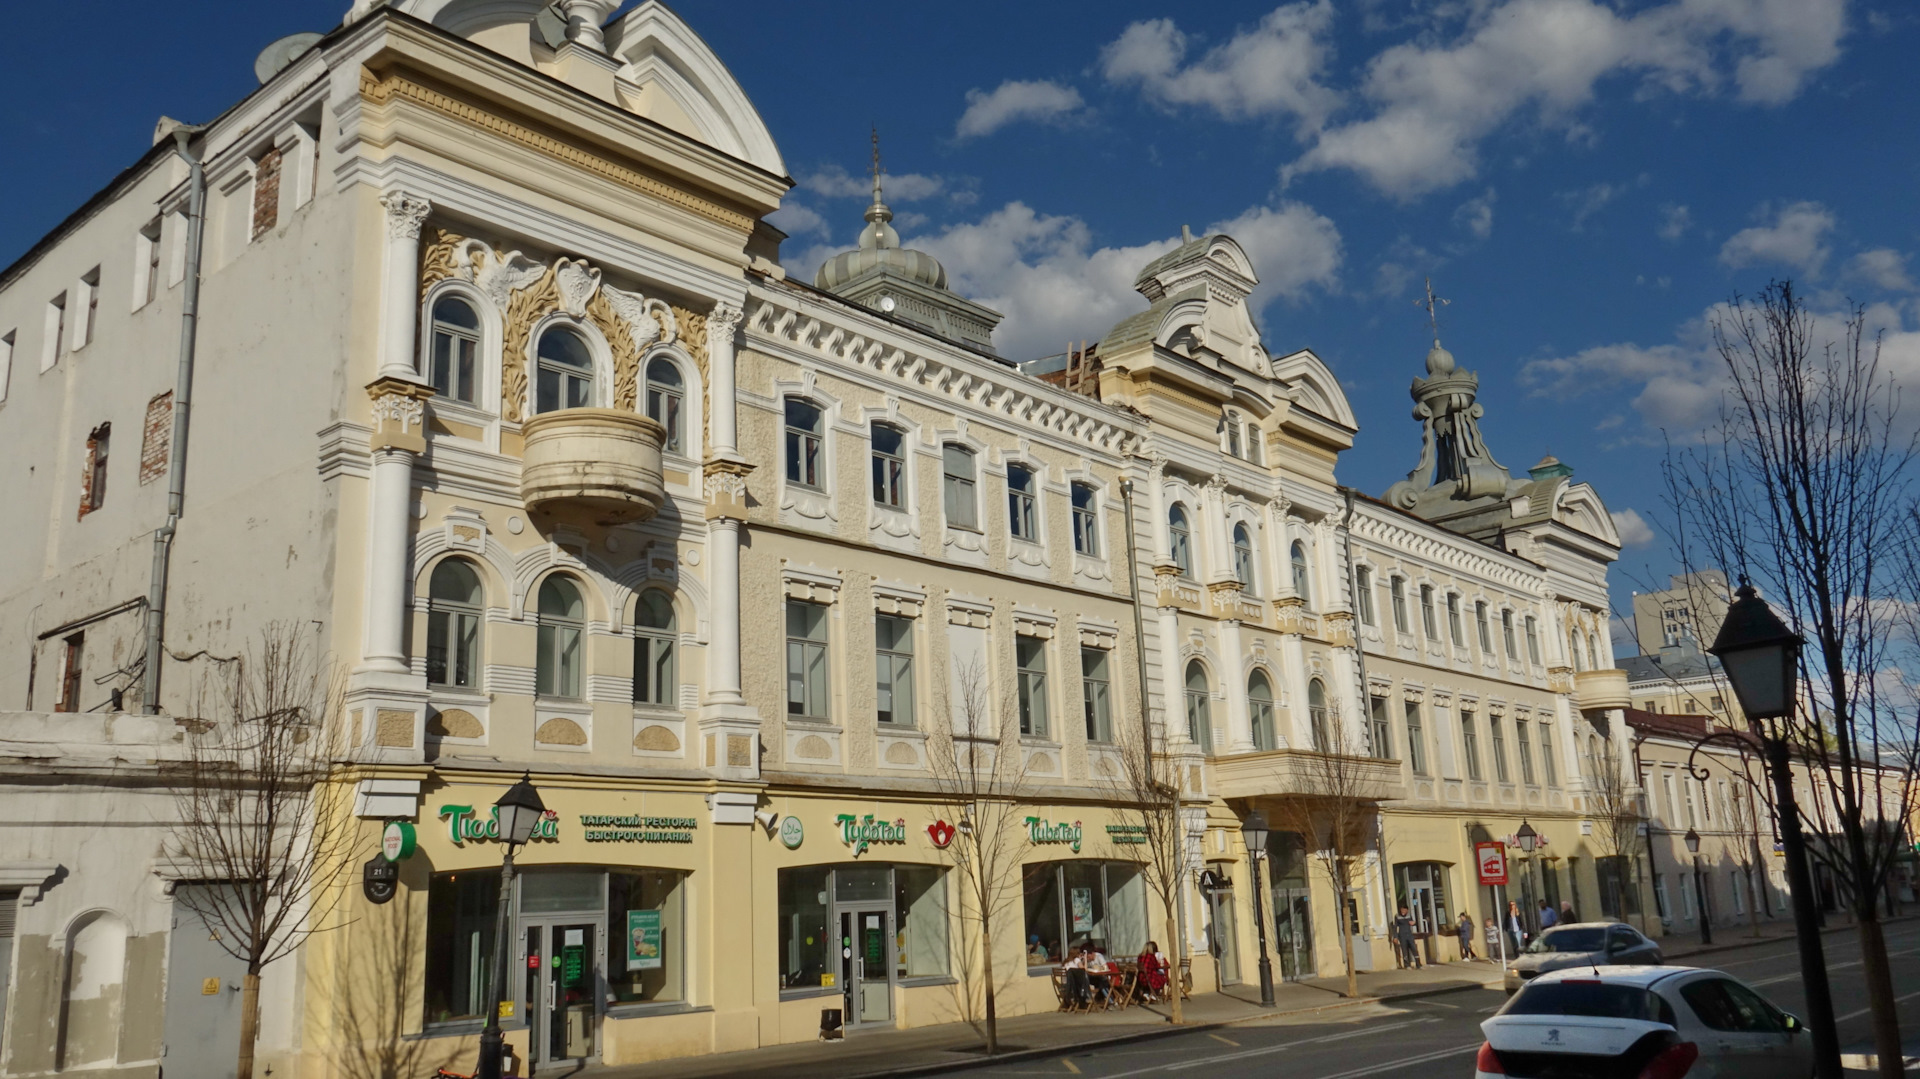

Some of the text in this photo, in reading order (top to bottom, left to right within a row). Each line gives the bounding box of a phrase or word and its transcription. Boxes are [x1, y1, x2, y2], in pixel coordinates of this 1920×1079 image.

[581, 814, 697, 828] ТАТАРСКИЙ РЕСТОРАН
[585, 830, 692, 842] БЫСТРОГО ПИТАНИЯ
